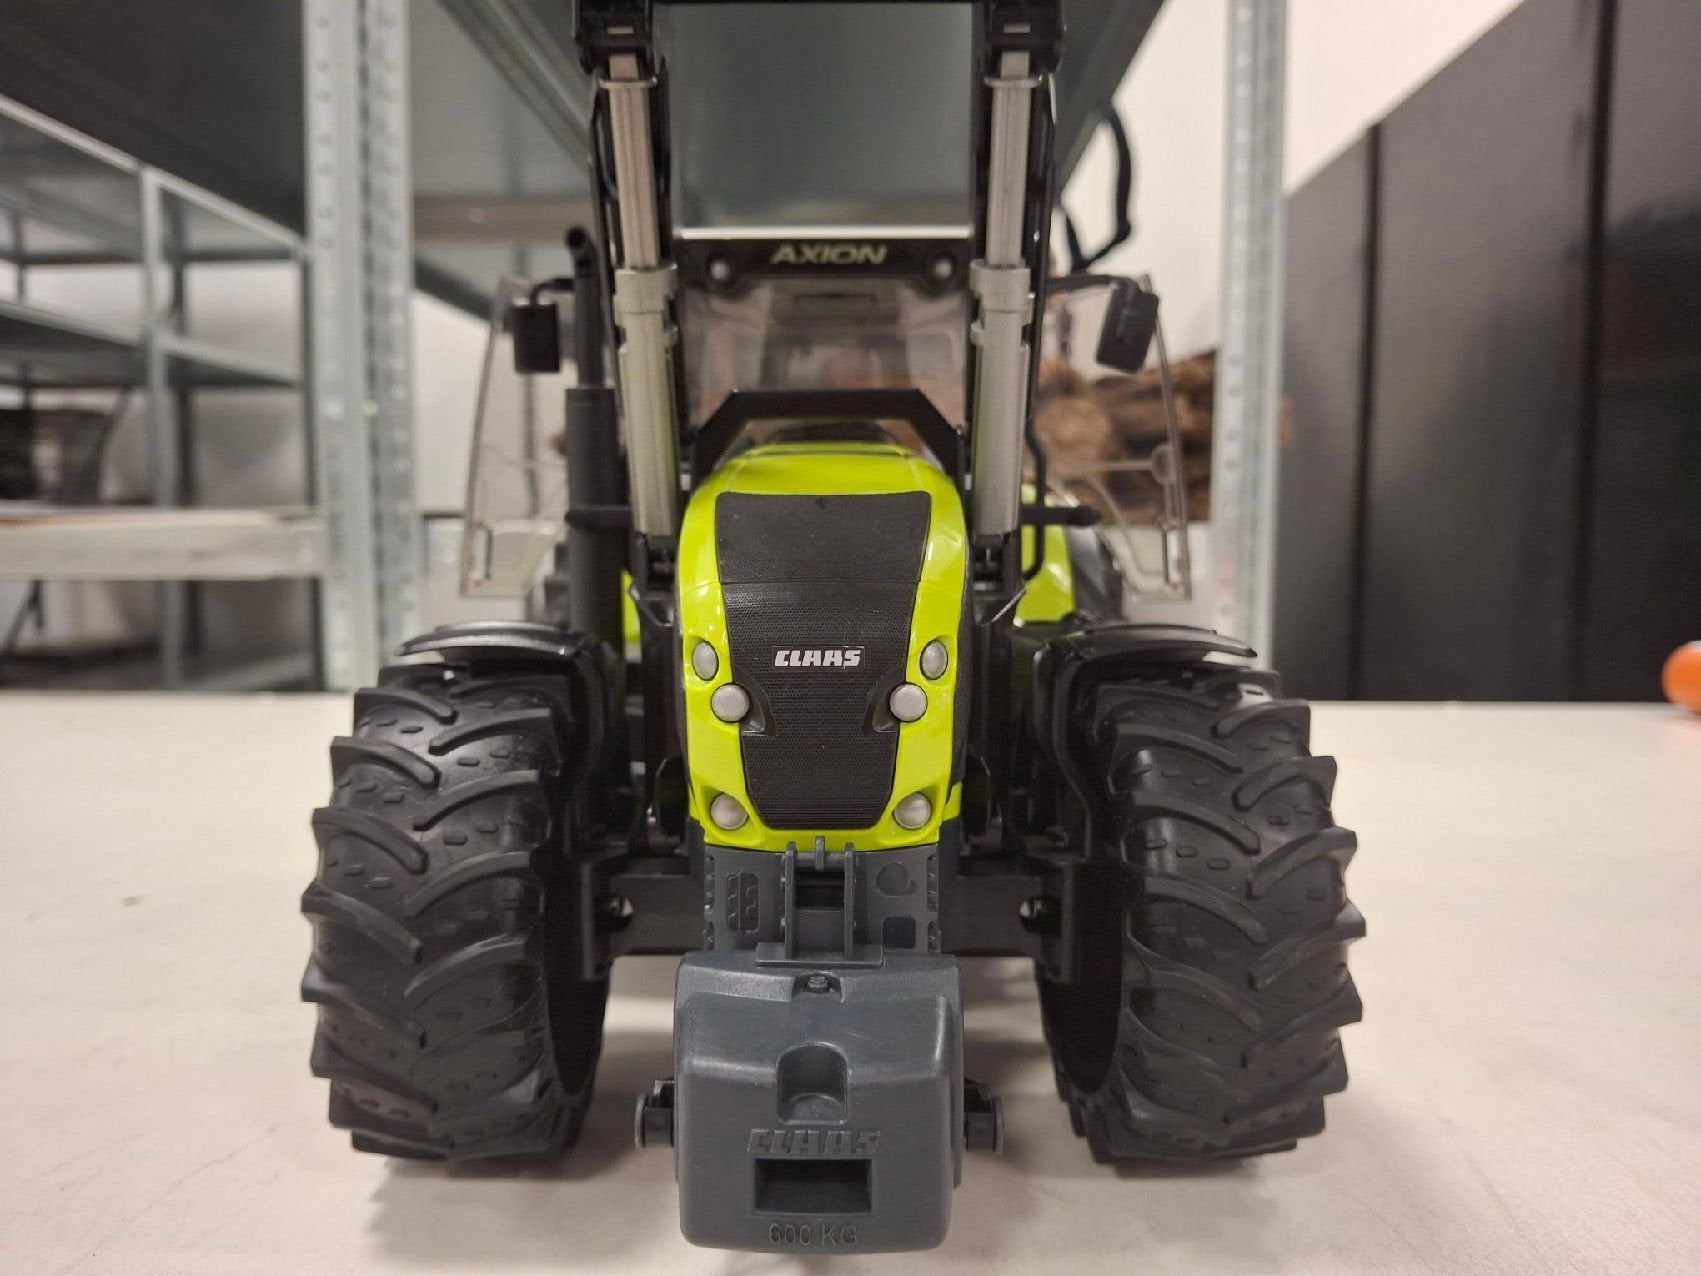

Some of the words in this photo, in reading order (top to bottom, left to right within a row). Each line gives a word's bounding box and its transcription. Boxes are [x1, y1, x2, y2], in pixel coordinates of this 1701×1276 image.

[770, 243, 887, 264] AXION
[774, 649, 862, 667] CLAAS
[747, 1128, 881, 1154] CLAAS
[768, 1222, 811, 1245] 600
[822, 1224, 858, 1246] KG
